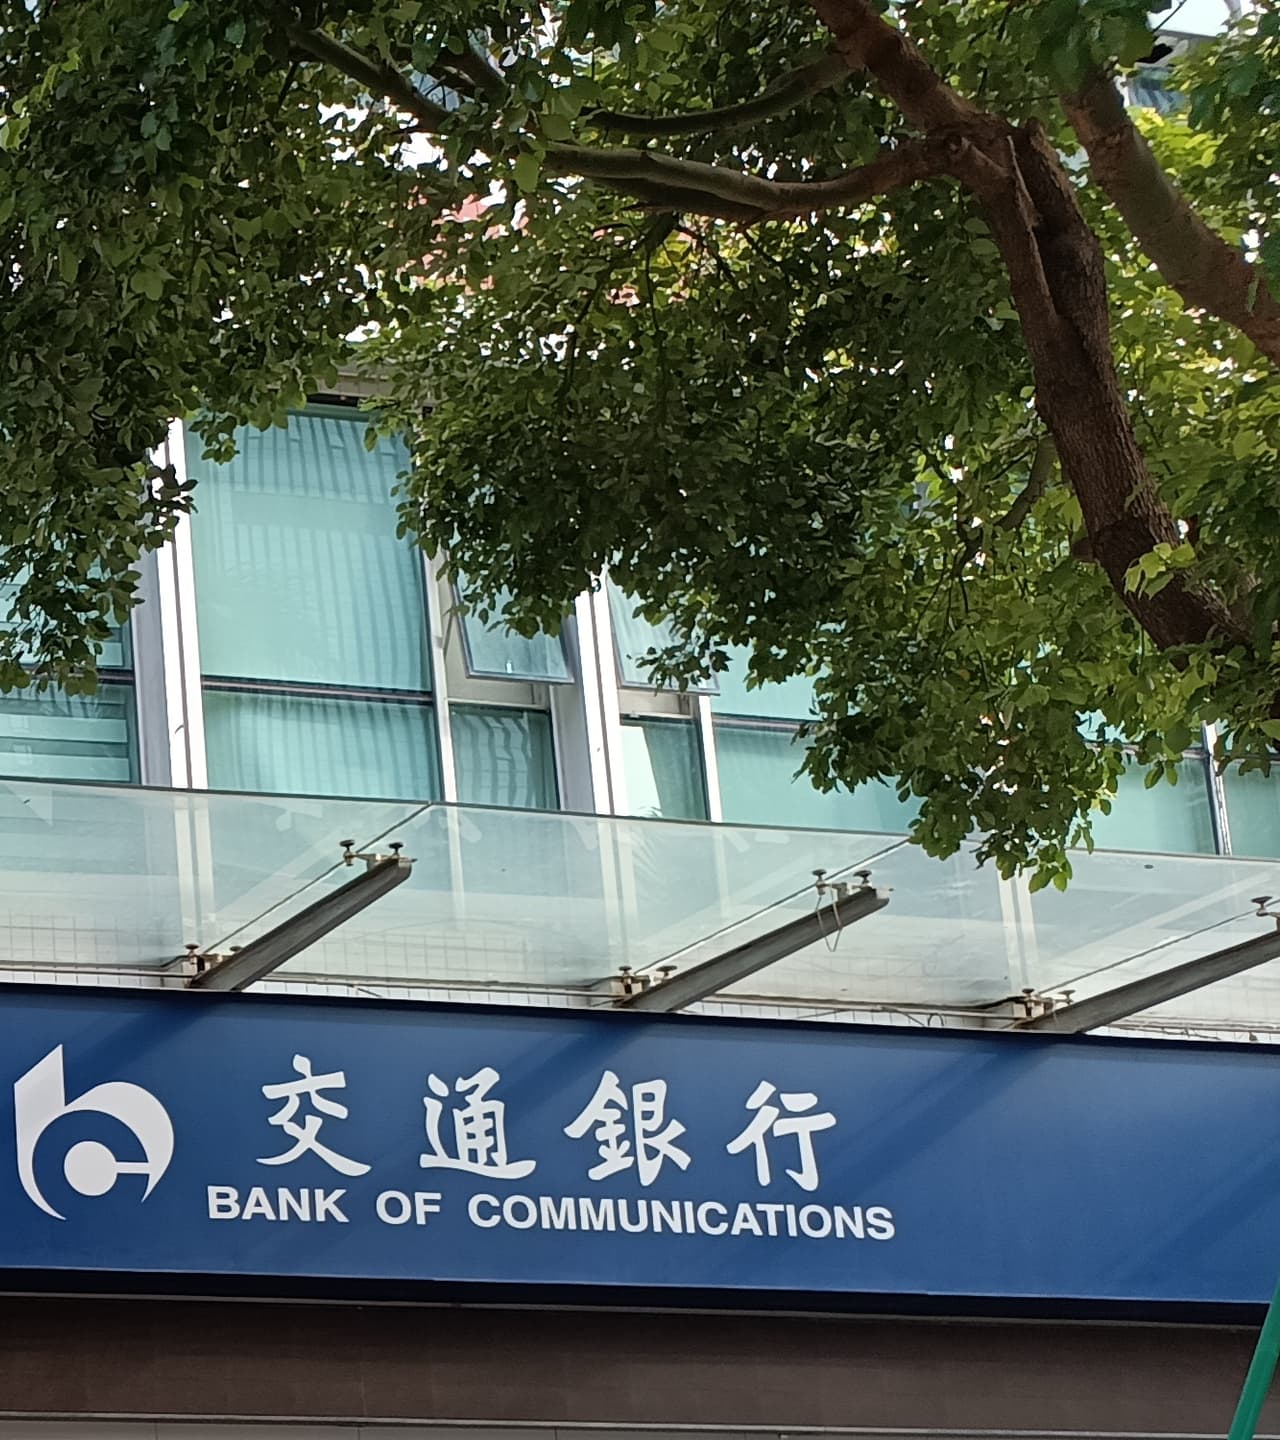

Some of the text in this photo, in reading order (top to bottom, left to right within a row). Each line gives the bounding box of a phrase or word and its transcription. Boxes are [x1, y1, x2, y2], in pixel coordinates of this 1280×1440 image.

[207, 1185, 896, 1240] BANK OF COMMUNICATIONS
